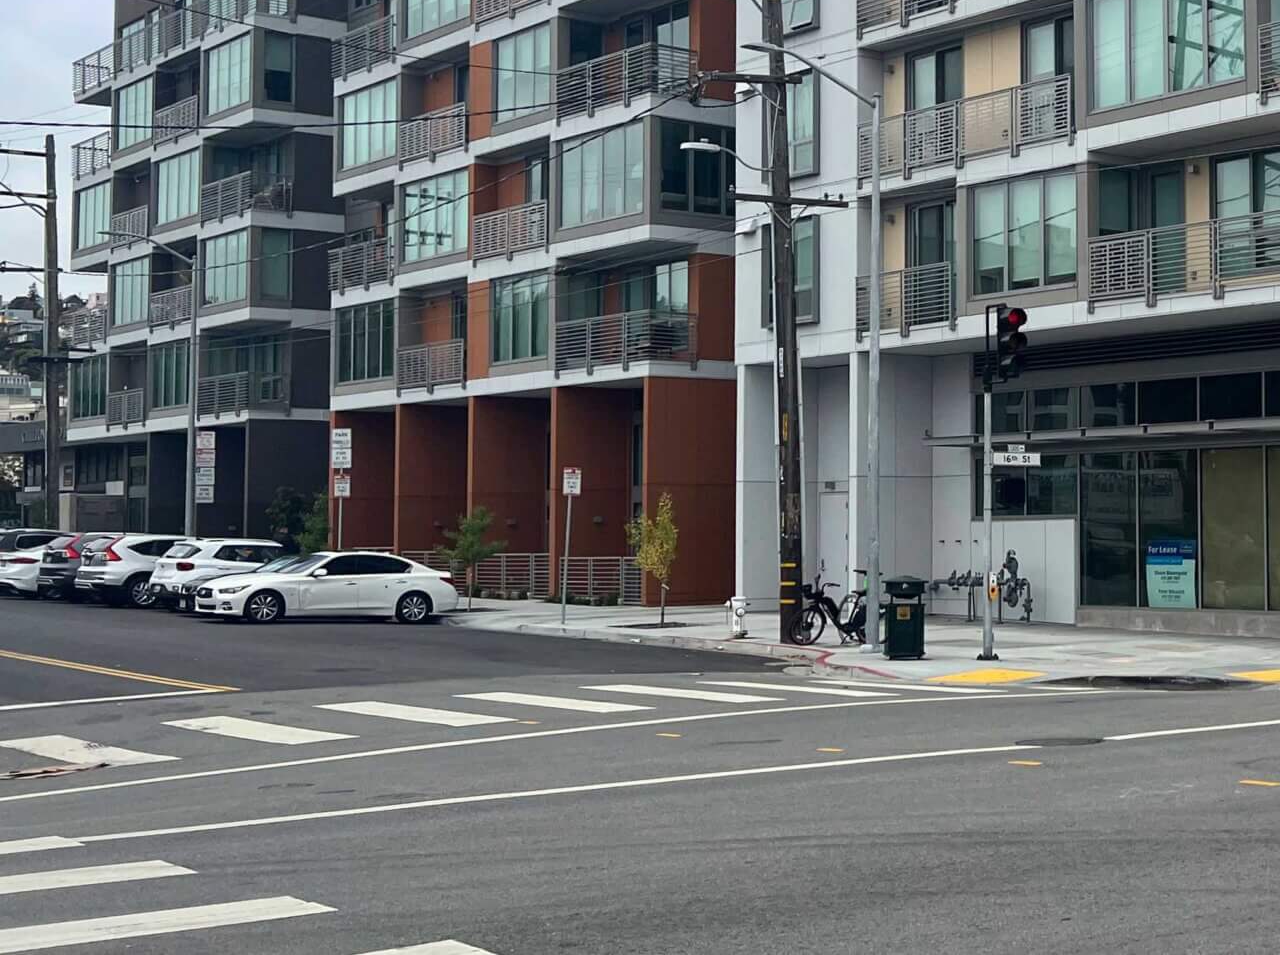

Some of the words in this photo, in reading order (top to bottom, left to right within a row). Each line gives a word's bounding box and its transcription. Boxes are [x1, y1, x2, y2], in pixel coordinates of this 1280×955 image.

[1022, 455, 1031, 464] St
[1148, 546, 1158, 554] For
[1159, 546, 1177, 554] Lease
